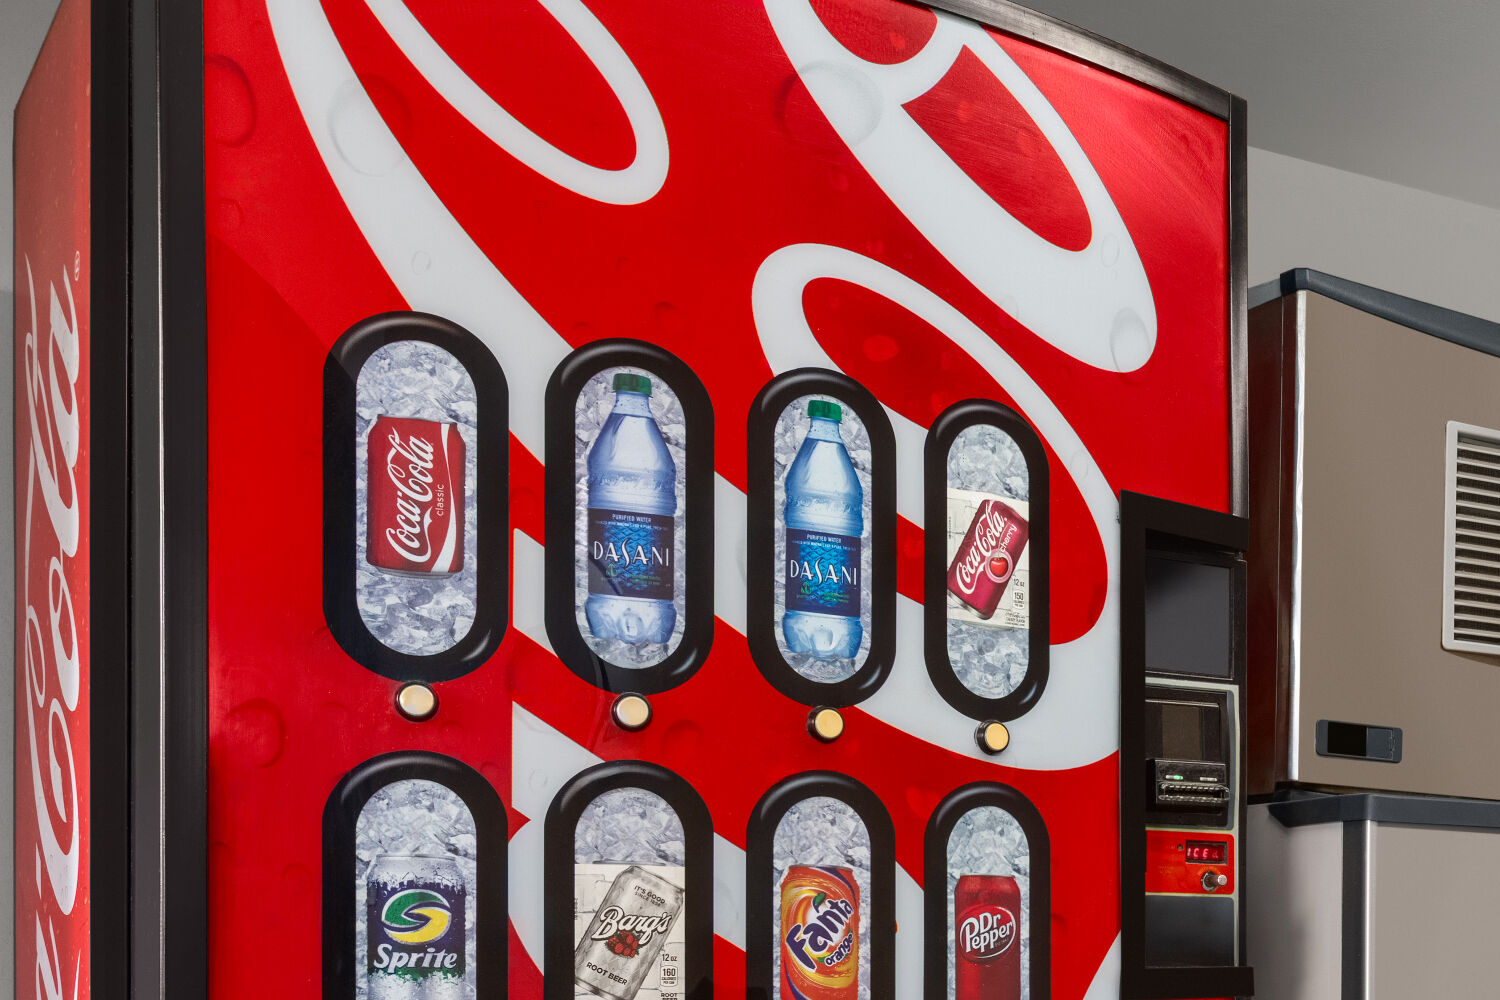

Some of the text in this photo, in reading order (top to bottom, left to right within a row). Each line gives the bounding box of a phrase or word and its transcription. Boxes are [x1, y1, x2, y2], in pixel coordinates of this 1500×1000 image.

[386, 426, 434, 563] Coca-Cola
[435, 483, 445, 517] classic
[612, 513, 635, 522] PURIFIED
[593, 537, 669, 569] DASANI
[807, 533, 842, 544] PURIFIED WATER
[956, 500, 1005, 595] Coca-Cola
[1000, 523, 1018, 553] cherry
[790, 557, 857, 586] DASANI
[1013, 578, 1020, 586] 12
[1014, 592, 1024, 601] 150
[634, 885, 666, 904] IT'S GOOD
[591, 905, 672, 946] Barq's
[786, 899, 854, 972] Fanta
[962, 917, 1013, 953] Pepper
[979, 912, 1001, 933] Dr
[373, 943, 458, 974] Sprite
[825, 932, 854, 966] orange
[586, 961, 628, 986] ROOT BEER
[662, 968, 676, 977] 160
